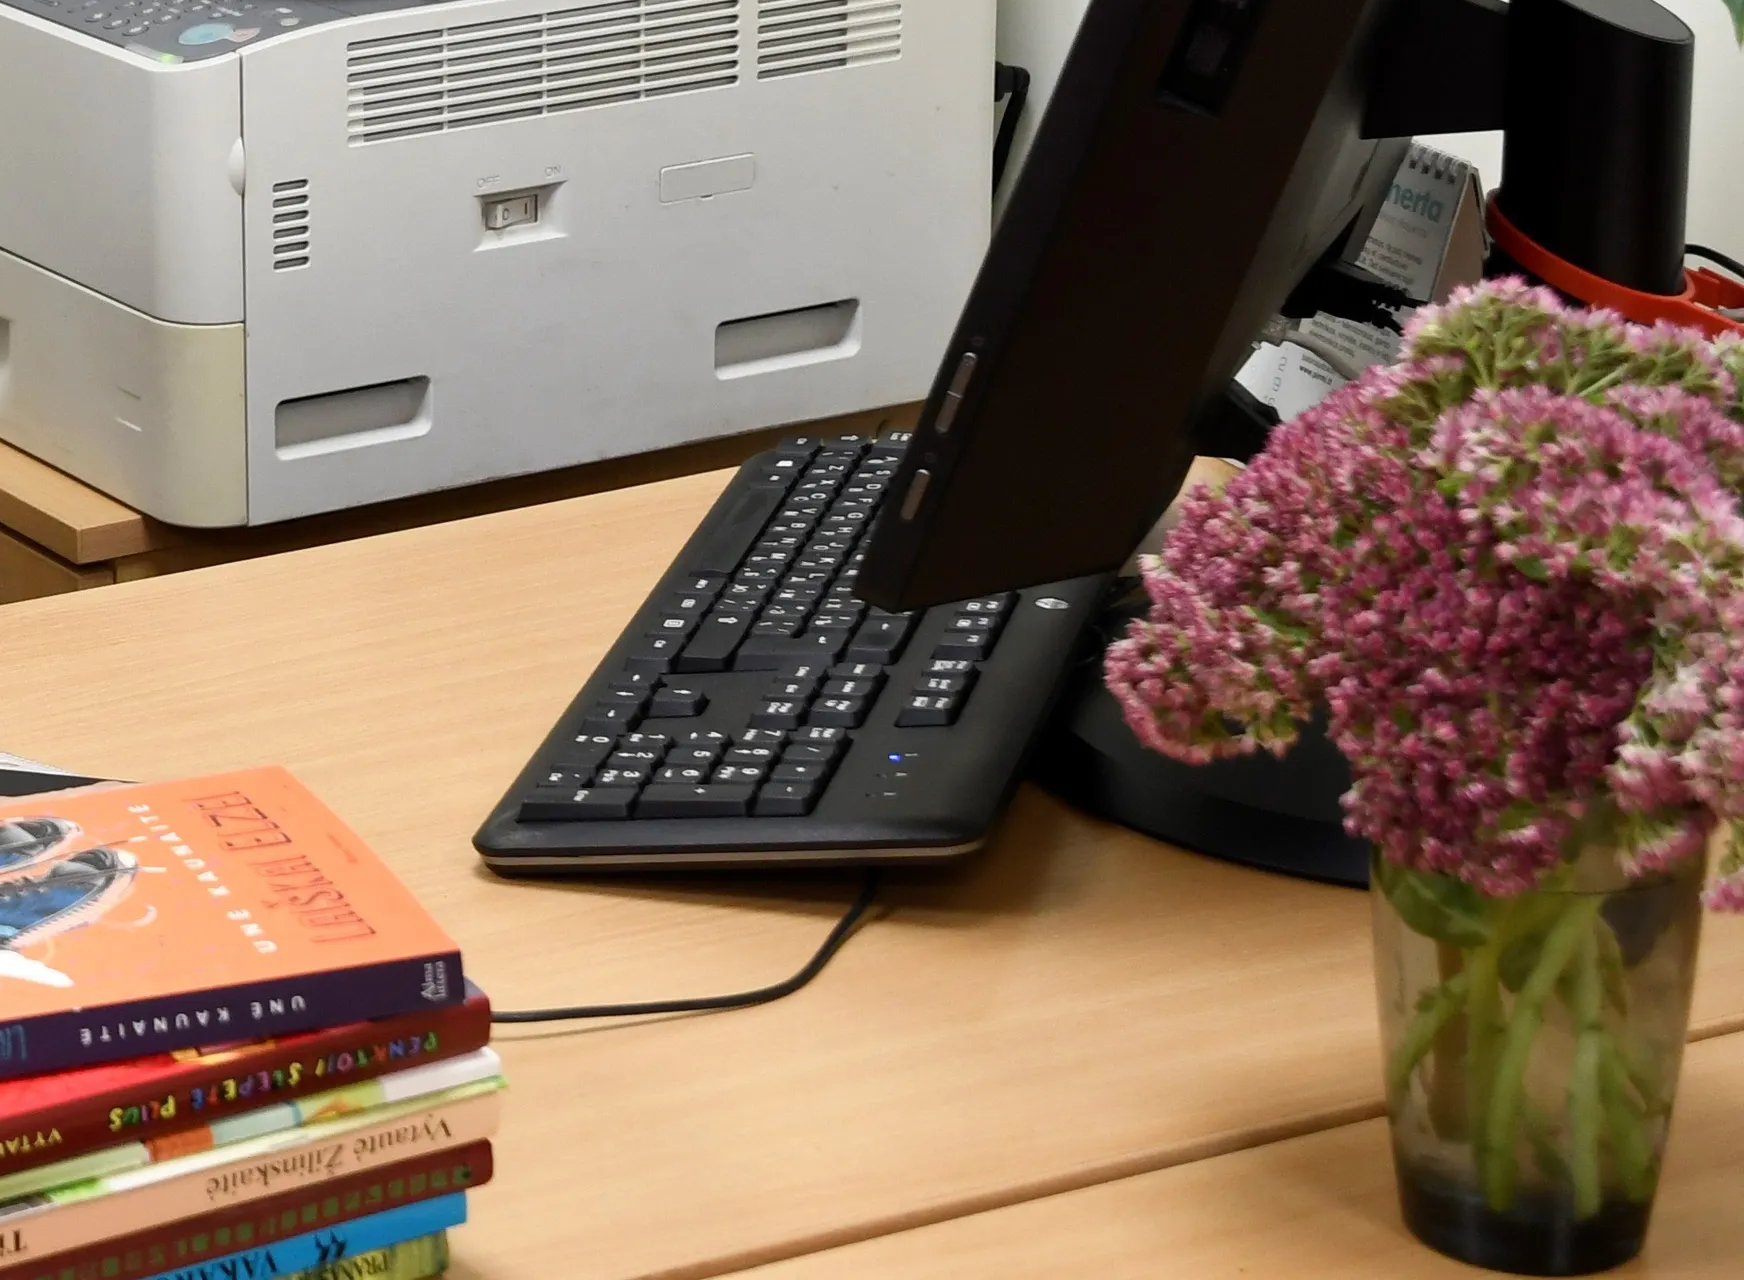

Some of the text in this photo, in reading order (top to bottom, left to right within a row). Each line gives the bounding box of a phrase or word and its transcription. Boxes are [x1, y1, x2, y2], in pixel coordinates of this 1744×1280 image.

[476, 173, 501, 189] OFF
[543, 165, 563, 178] ON
[353, 1113, 453, 1163] Vytautė
[206, 1141, 346, 1201] Žilinskaitė
